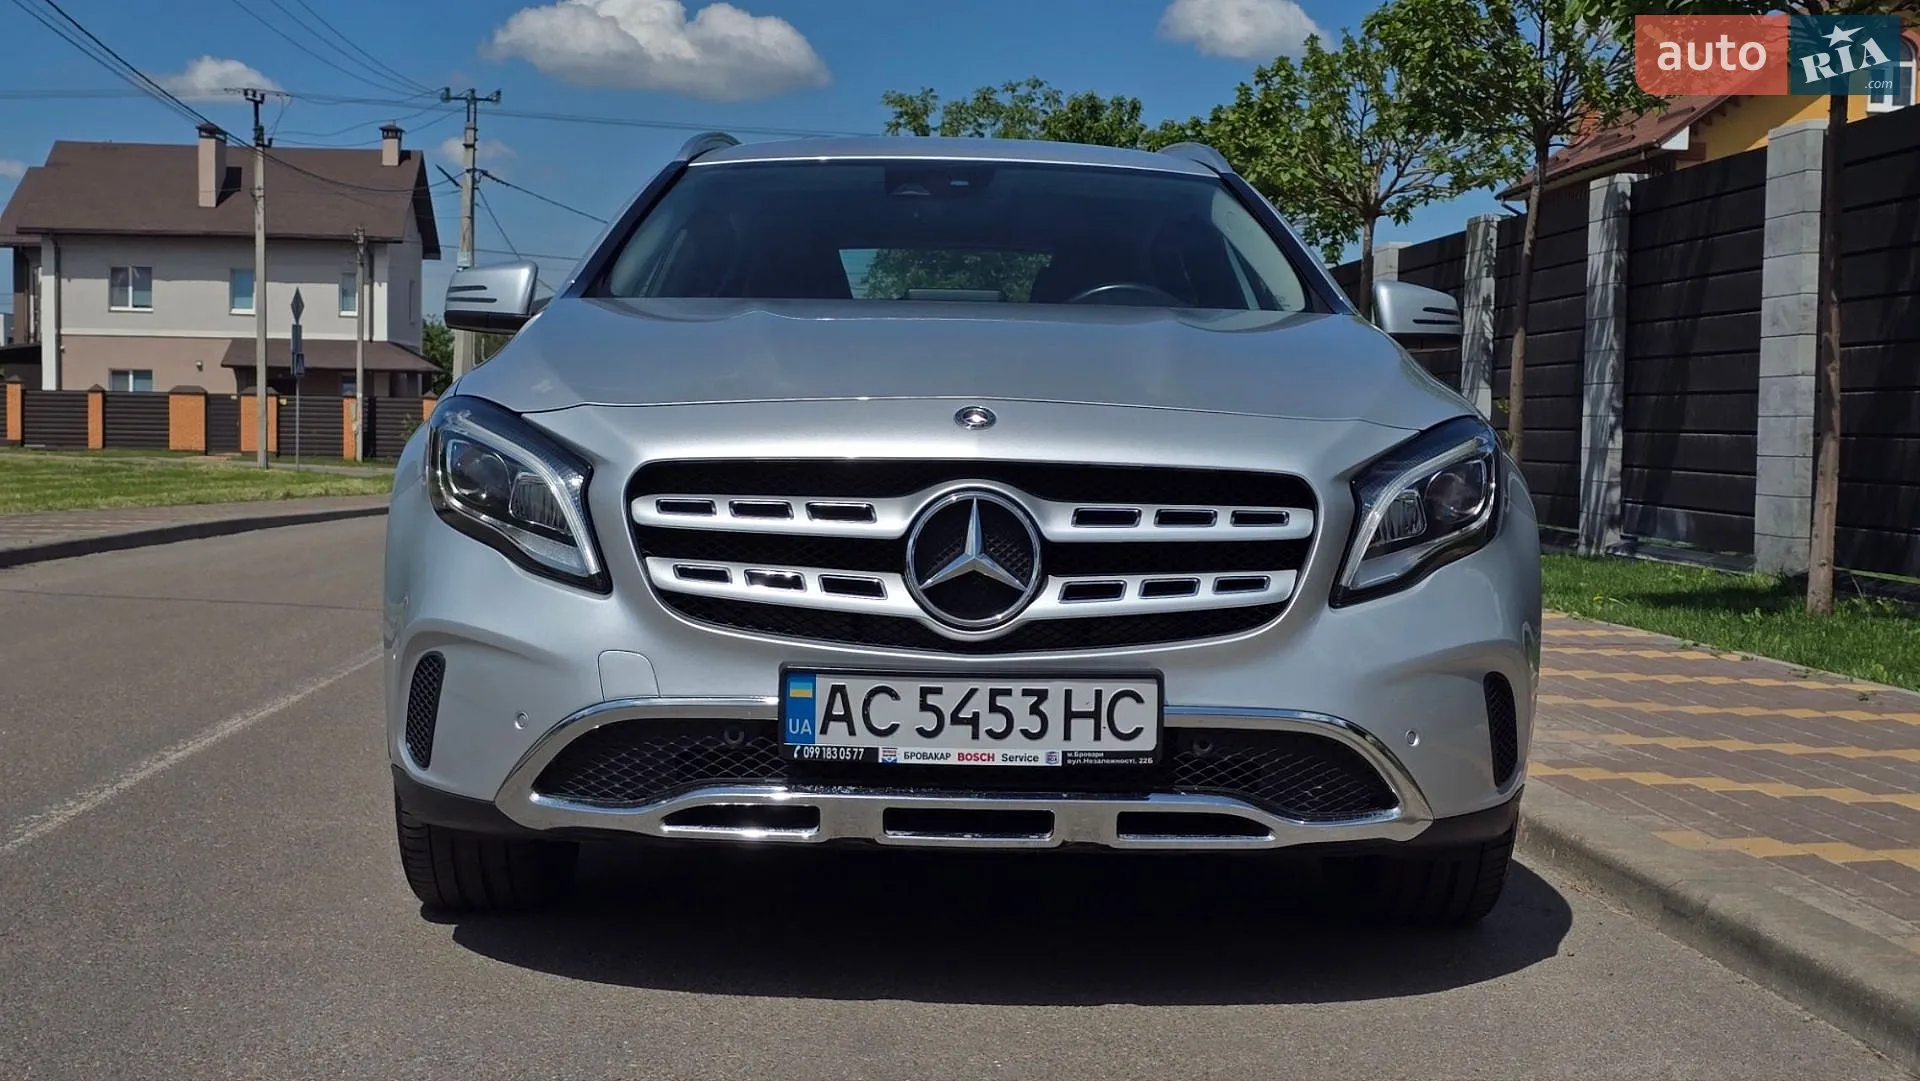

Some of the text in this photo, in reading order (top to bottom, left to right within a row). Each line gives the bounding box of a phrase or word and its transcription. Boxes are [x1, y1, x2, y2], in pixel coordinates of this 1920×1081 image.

[819, 684, 1145, 741] AC 5453 HC
[789, 718, 812, 735] UA
[903, 751, 951, 761] БРОВАКАР
[957, 752, 995, 762] BOSCH
[1001, 753, 1039, 763] Service
